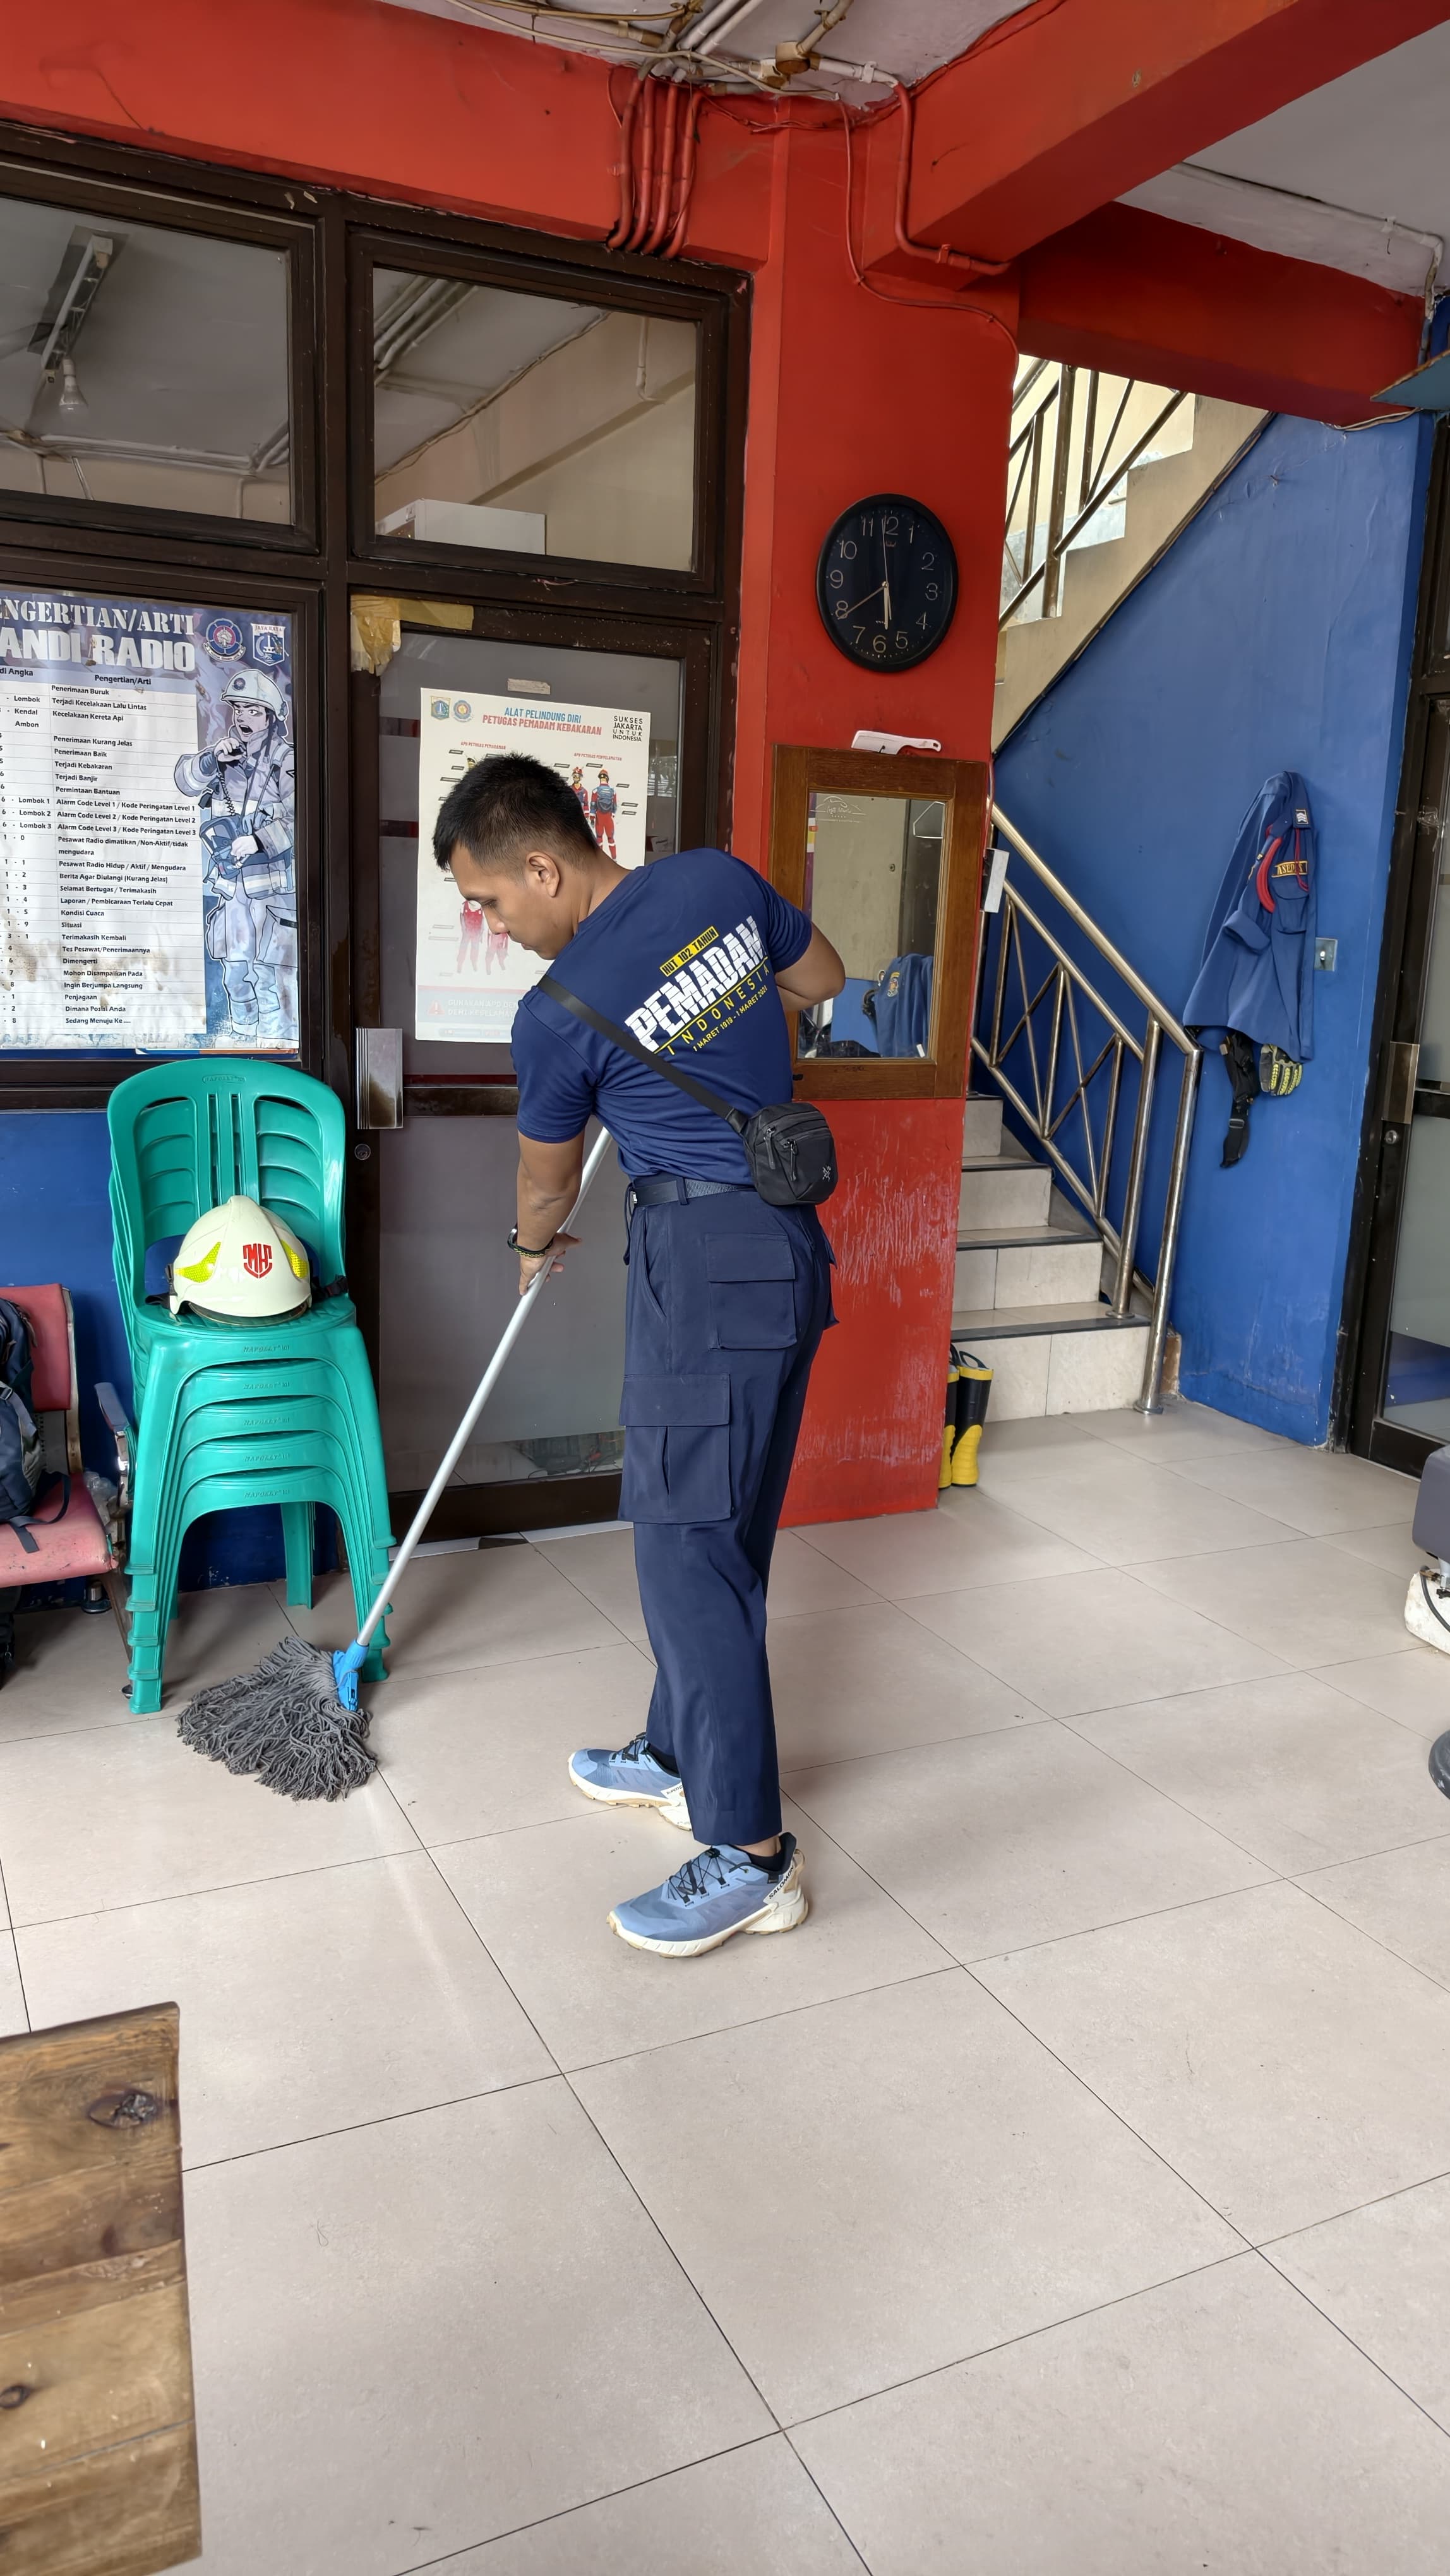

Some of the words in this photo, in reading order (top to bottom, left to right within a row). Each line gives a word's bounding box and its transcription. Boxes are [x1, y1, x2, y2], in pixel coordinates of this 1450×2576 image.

[863, 516, 873, 537] 11
[840, 540, 858, 559] 10
[921, 552, 935, 570] 2
[830, 569, 844, 589] 9
[925, 583, 938, 600] 3
[0, 599, 194, 635] NGERTIAN/ARTI
[835, 600, 849, 619] 8
[916, 612, 928, 630] 4
[853, 625, 866, 643] 7
[895, 631, 908, 649] 5
[873, 635, 886, 653] 6
[92, 635, 195, 672] RADIO
[8, 668, 33, 677] Angka
[95, 675, 152, 685] Pengertian/Arti
[51, 685, 88, 694] Penerimaan
[76, 700, 111, 708] Kecelakaan
[52, 711, 89, 719] Kecelakaan
[505, 707, 524, 717] ALAT
[525, 709, 566, 722] PELINDUNG
[568, 714, 582, 724] DIRI
[614, 715, 643, 724] SUKSES
[482, 715, 517, 727] PETUGAS
[519, 718, 556, 730] PEMADAM
[557, 723, 602, 735] KEBAKARAN
[613, 722, 642, 731] JAKARTA
[613, 729, 642, 737] UNTUK
[54, 736, 91, 744] Penerimaan
[92, 739, 116, 747] Kurang
[54, 748, 92, 756] Penerimaan
[55, 761, 77, 769] Terjadi
[79, 775, 98, 783] Banjir
[56, 786, 92, 794] Permintaan
[139, 803, 173, 811] Peringatan
[124, 875, 150, 883] (Kurang
[662, 959, 678, 975] HUT
[678, 948, 693, 962] 102
[692, 928, 717, 951] TAHUN
[624, 915, 768, 1052] PEMADAM
[667, 966, 769, 1056] INDONESIA
[697, 1027, 720, 1049] MARET
[720, 1017, 733, 1030] 1919
[740, 994, 758, 1014] MARET
[757, 984, 768, 998] 2021
[769, 1865, 794, 1900] SALOMON
